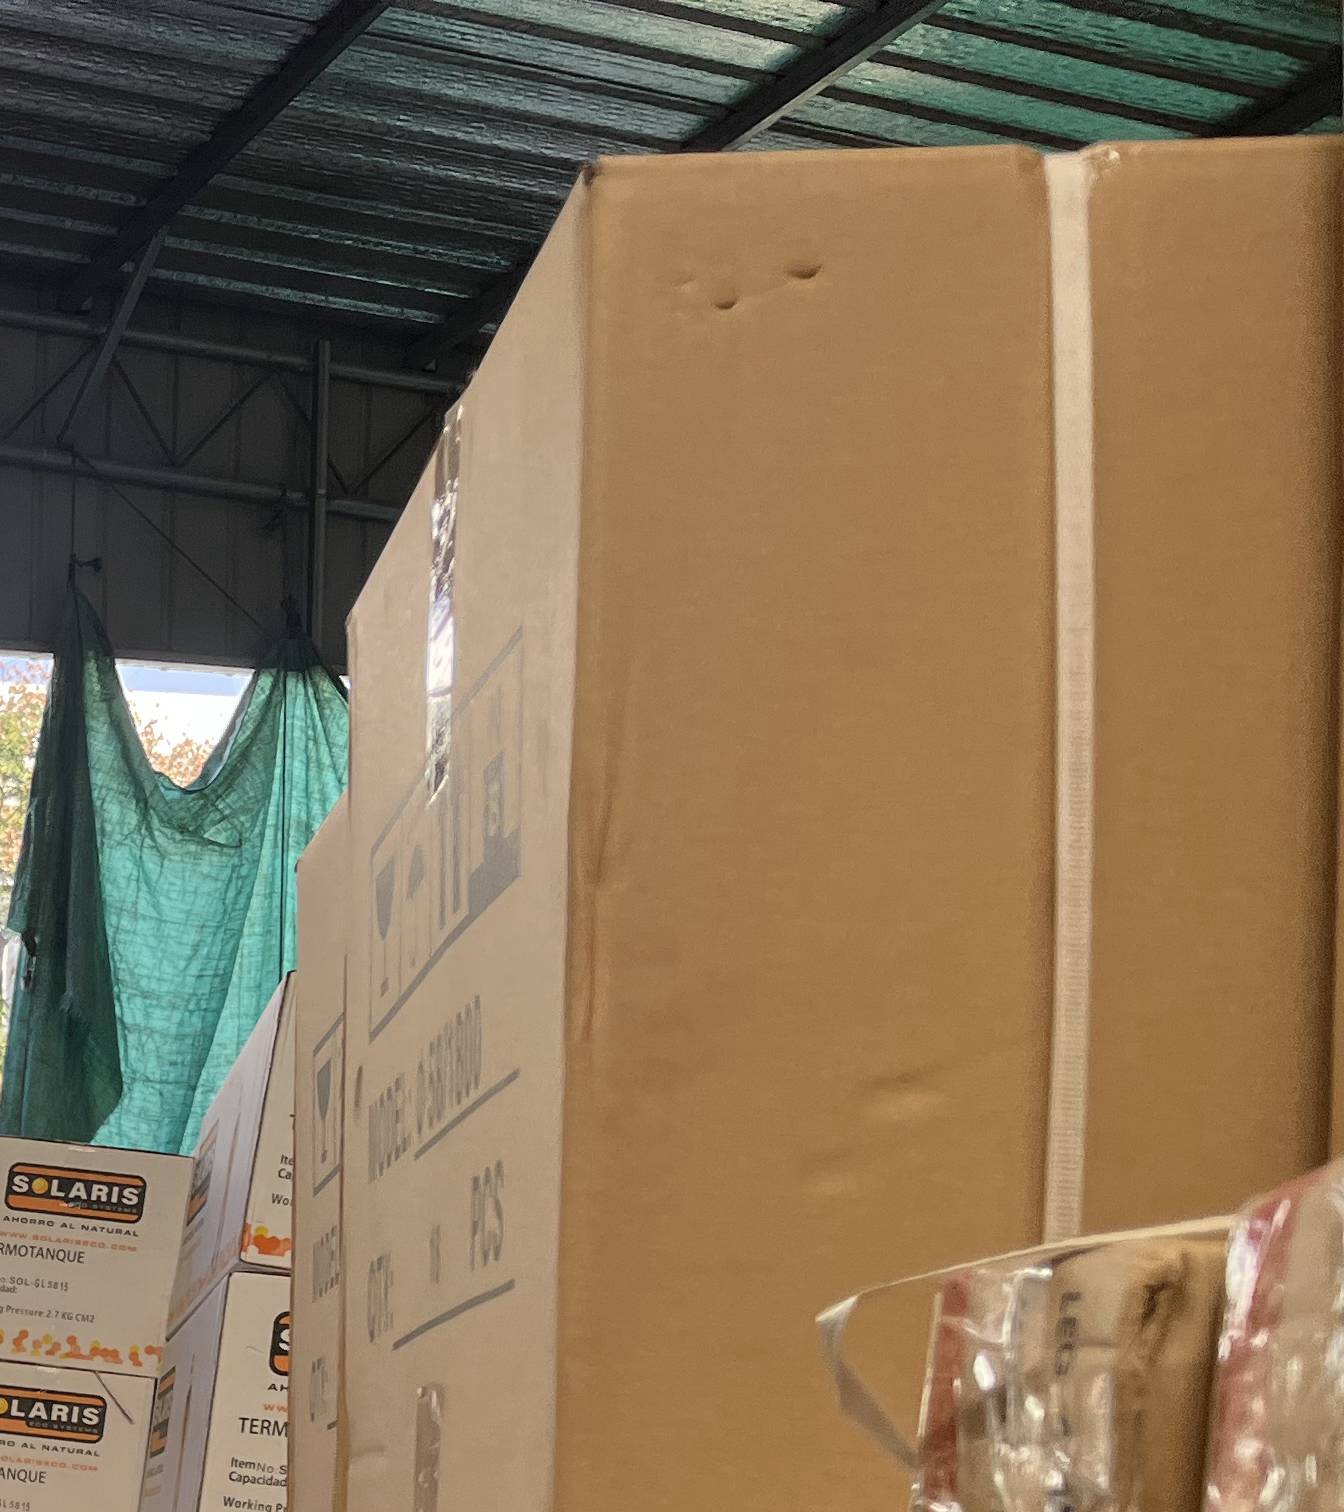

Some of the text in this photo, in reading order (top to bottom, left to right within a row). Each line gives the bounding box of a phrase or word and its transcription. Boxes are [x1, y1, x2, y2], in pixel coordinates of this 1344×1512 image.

[12, 1175, 139, 1205] SOLARIS
[3, 1216, 138, 1237] AHORRO AL NATURAL
[41, 1445, 100, 1457] NATURAL
